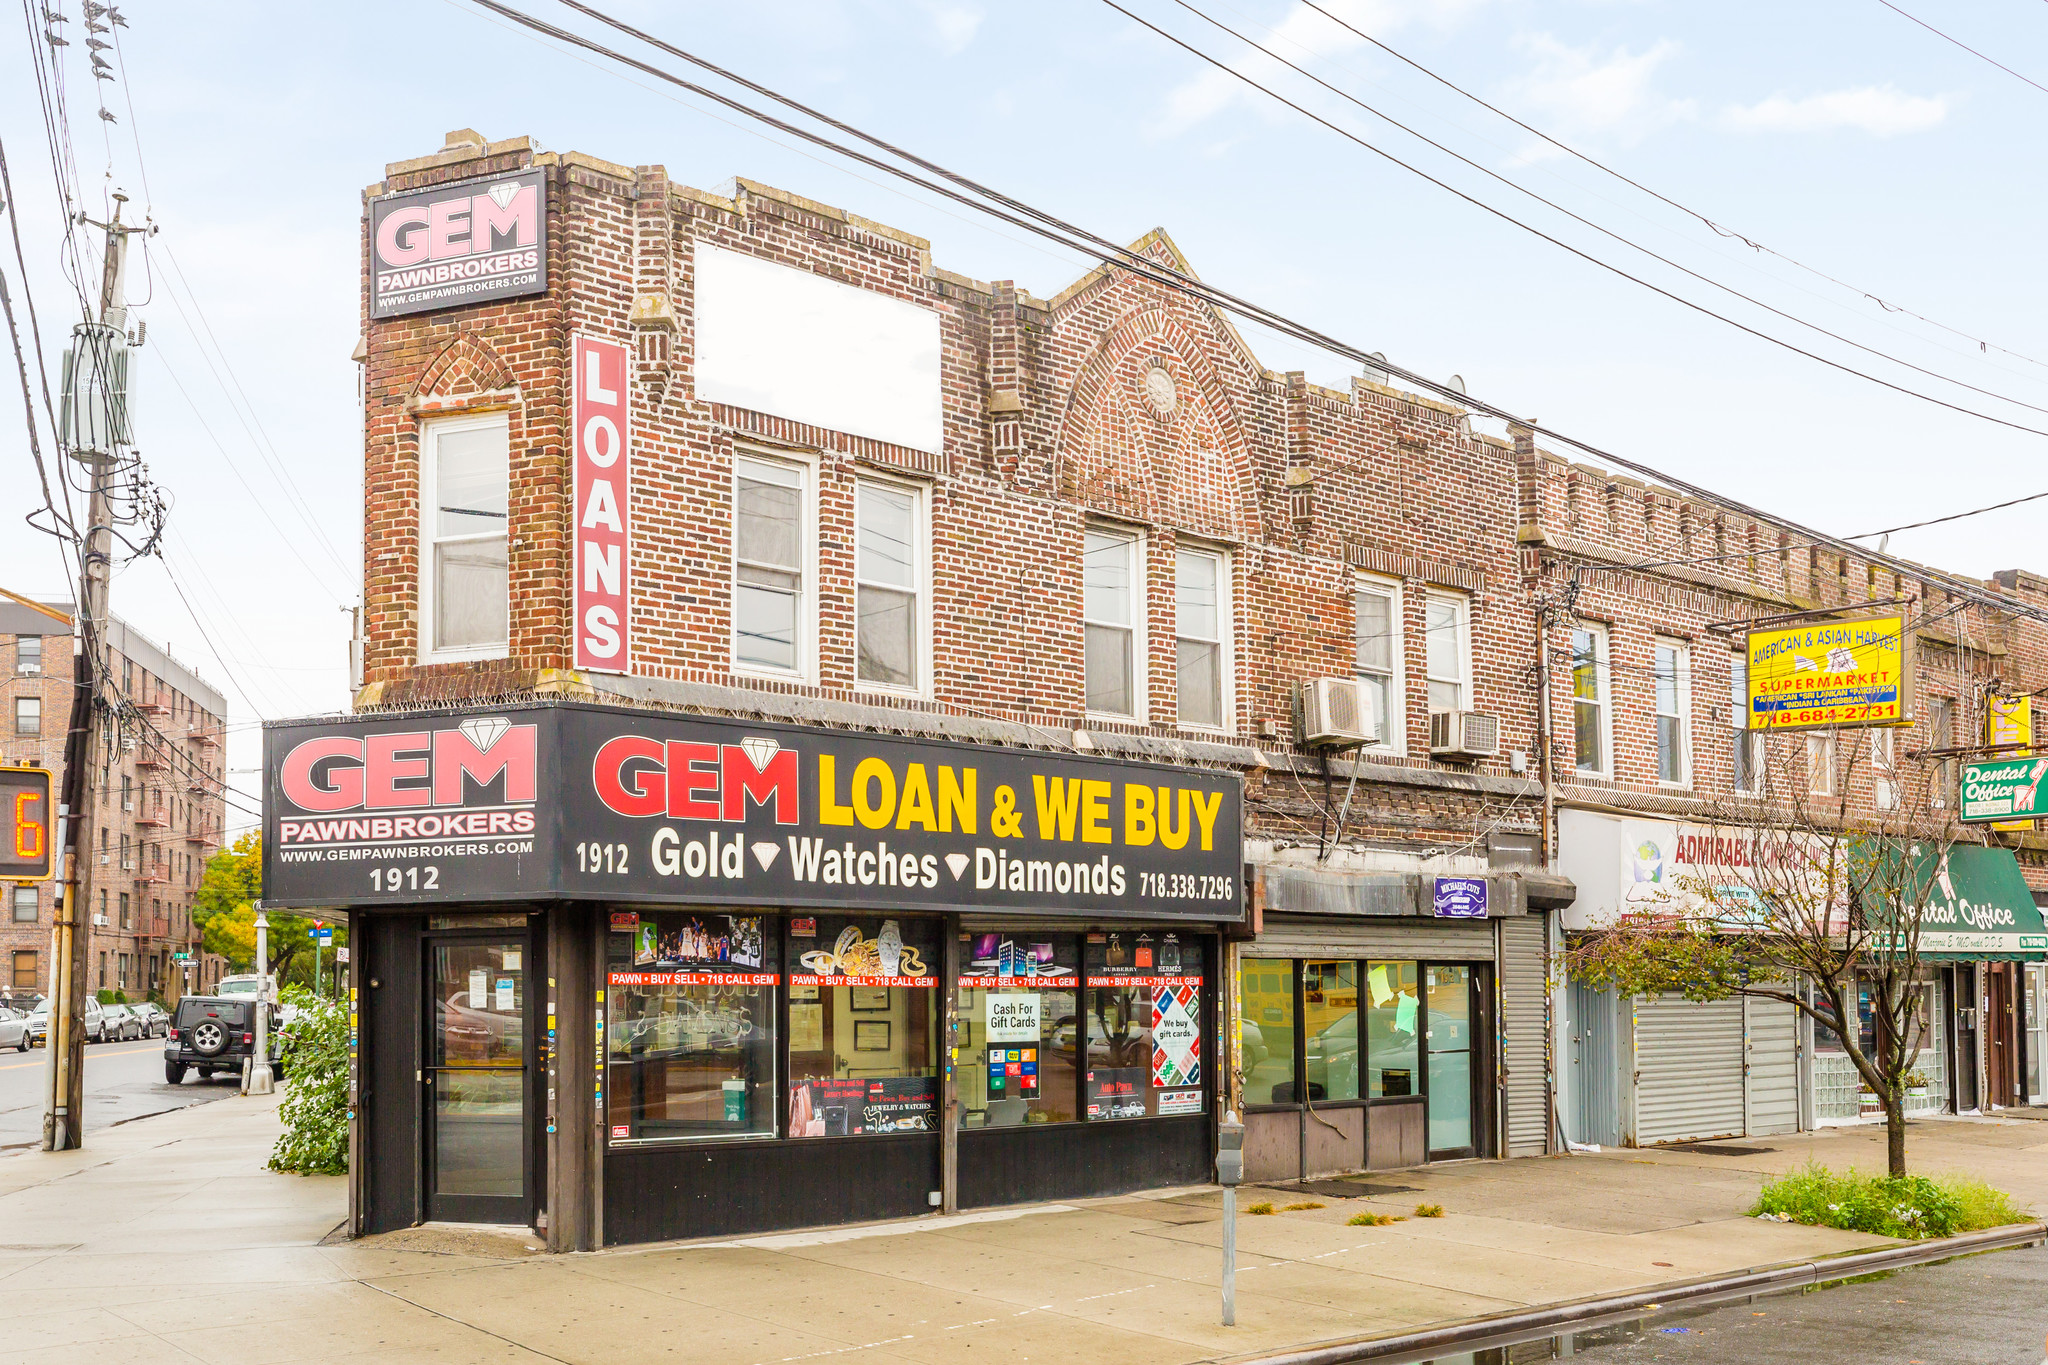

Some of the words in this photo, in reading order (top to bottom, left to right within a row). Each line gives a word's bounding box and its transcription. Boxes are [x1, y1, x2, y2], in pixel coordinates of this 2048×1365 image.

[377, 184, 538, 267] GEM
[378, 250, 538, 292] PAWNBROKERS
[378, 273, 537, 307] WWW.GEMPAWNBROKERS.COM
[581, 350, 624, 658] LOANS
[1753, 634, 1801, 666] AMERICAN
[1805, 632, 1813, 648] &
[1817, 629, 1851, 646] ASIAN
[1856, 630, 1898, 653] HARVEST
[1760, 671, 1889, 693] SUPERMARKET
[1816, 689, 1848, 698] LANKAN
[1821, 696, 1865, 706] CARIBBEAN
[1755, 704, 1895, 726] 718-684-2731
[280, 723, 538, 813] GEM
[1965, 764, 2029, 784] Dental
[592, 734, 800, 826] GEM
[818, 754, 977, 834] LOAN
[990, 784, 1025, 839] &
[1032, 774, 1113, 844] WE
[1125, 783, 1224, 851] BUY
[1965, 783, 2014, 802] Office
[16, 792, 44, 858] 6
[280, 810, 536, 843] PAWNBROKERS
[279, 841, 534, 863] WWW.GEMPAWNBROKERS.COM
[576, 842, 629, 875] 1912
[651, 827, 744, 879] Gold
[787, 835, 939, 888] Watches
[975, 847, 1126, 896] Diamonds
[1675, 834, 1758, 868] ADMIRABLE
[369, 866, 440, 892] 1912
[1139, 872, 1233, 901] 718.338.7296
[1467, 883, 1481, 895] CUTS
[611, 912, 639, 925] GEM
[1959, 899, 2015, 930] Office
[612, 974, 642, 984] PAWN
[650, 974, 673, 984] BUY
[674, 975, 699, 984] SELL
[707, 975, 723, 984] 718
[725, 975, 751, 985] CALL
[753, 975, 774, 985] GEM
[792, 976, 818, 985] PAWN
[825, 976, 845, 986] BUY
[846, 977, 868, 986] SELL
[875, 977, 890, 986] 718
[891, 977, 914, 986] CALL
[915, 977, 934, 986] GEM
[958, 977, 974, 986] AWN
[980, 977, 997, 986] BUY
[998, 977, 1018, 986] SELL
[1023, 977, 1037, 986] 718
[1037, 977, 1058, 986] CALL
[1058, 977, 1076, 987] GEM
[1088, 977, 1109, 986] PAWN
[1115, 977, 1130, 986] BUY
[1130, 977, 1148, 986] SELL
[1153, 977, 1165, 986] 718
[1165, 977, 1183, 986] CALL
[1184, 977, 1199, 986] GEM
[993, 1002, 1016, 1014] Cash
[1019, 1003, 1033, 1014] For
[991, 1016, 1007, 1028] Gift
[1010, 1016, 1036, 1028] Cards
[1175, 1019, 1188, 1028] buy
[1159, 1030, 1171, 1039] gift
[1172, 1030, 1193, 1038] cards.
[823, 1090, 842, 1099] Luxury
[898, 1094, 911, 1102] Buy
[912, 1094, 923, 1102] and
[923, 1093, 935, 1102] Sell
[1100, 1082, 1115, 1092] Auto
[1115, 1081, 1133, 1092] Pawn
[870, 1103, 898, 1112] JEWELRY
[904, 1102, 931, 1111] WATCHES
